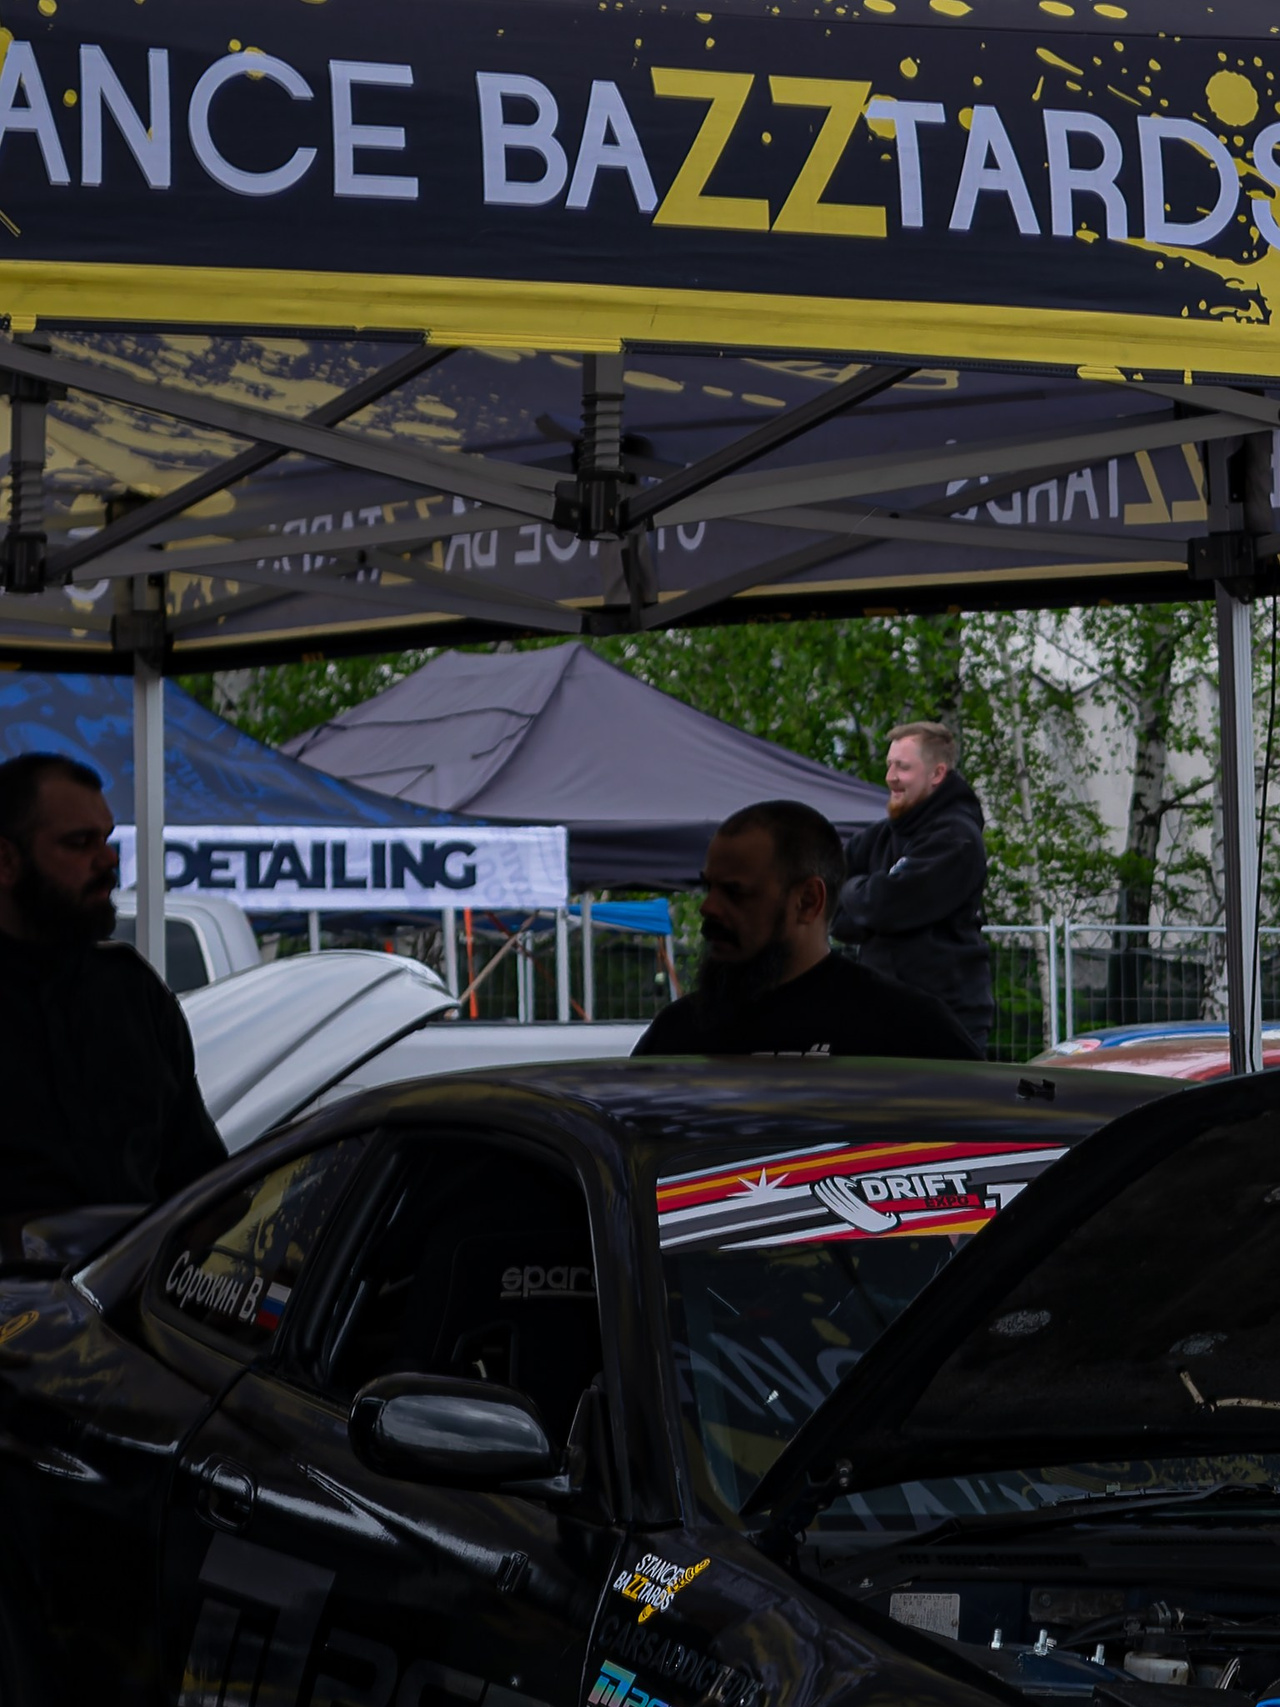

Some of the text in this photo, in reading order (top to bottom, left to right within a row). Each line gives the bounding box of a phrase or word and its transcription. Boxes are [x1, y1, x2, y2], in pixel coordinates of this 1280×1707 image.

[164, 839, 478, 890] DETAILING
[861, 1173, 968, 1202] DRIFT
[925, 1195, 970, 1209] EXPO
[165, 1250, 245, 1317] Сорокин
[501, 1264, 597, 1298] spar
[635, 1552, 686, 1587] STANCE
[612, 1569, 676, 1614] BAZZTARDS
